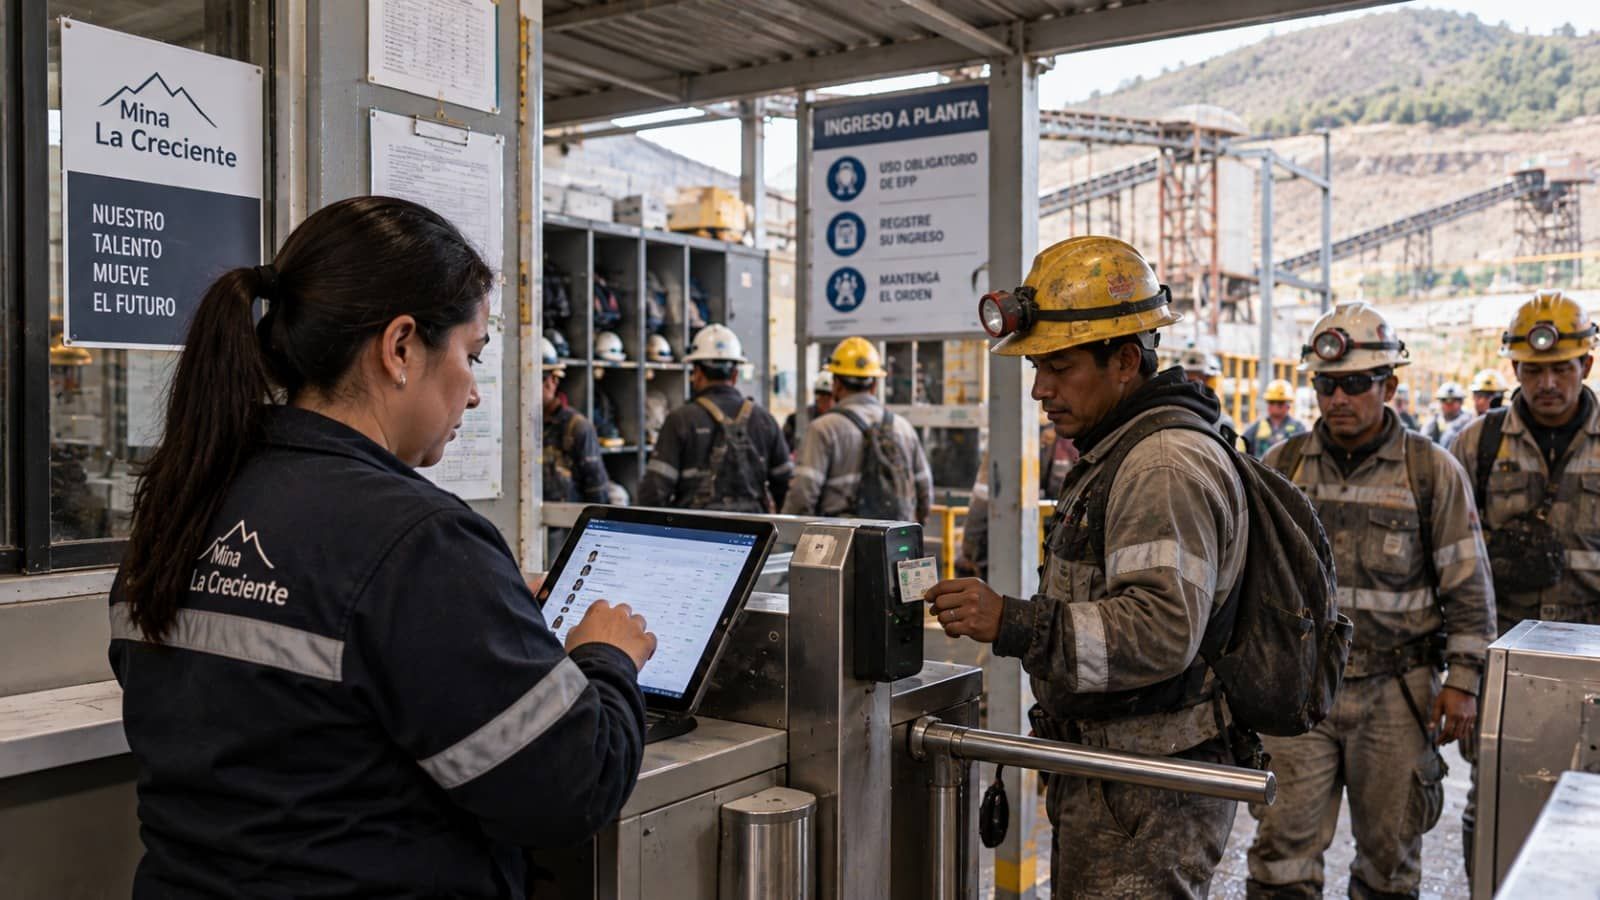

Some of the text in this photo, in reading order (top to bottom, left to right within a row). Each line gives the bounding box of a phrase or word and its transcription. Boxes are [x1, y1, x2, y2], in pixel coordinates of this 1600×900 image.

[120, 99, 169, 128] Mina
[824, 99, 980, 137] INGRESO A PLANTA
[96, 121, 237, 168] La Creciente
[879, 152, 978, 174] USO OBLIGATORIO
[879, 175, 917, 190] DE EPP
[92, 203, 165, 231] NUESTRO
[879, 214, 932, 230] REGISTRE
[92, 233, 162, 259] TALENTO
[879, 230, 944, 246] SU INGRESO
[93, 262, 149, 286] MUEVE
[879, 271, 941, 286] MANTENGA
[94, 292, 176, 317] EL FUTURO
[879, 288, 932, 303] EL ORDEN
[210, 544, 241, 567] Mina
[189, 568, 289, 606] La Creciente
